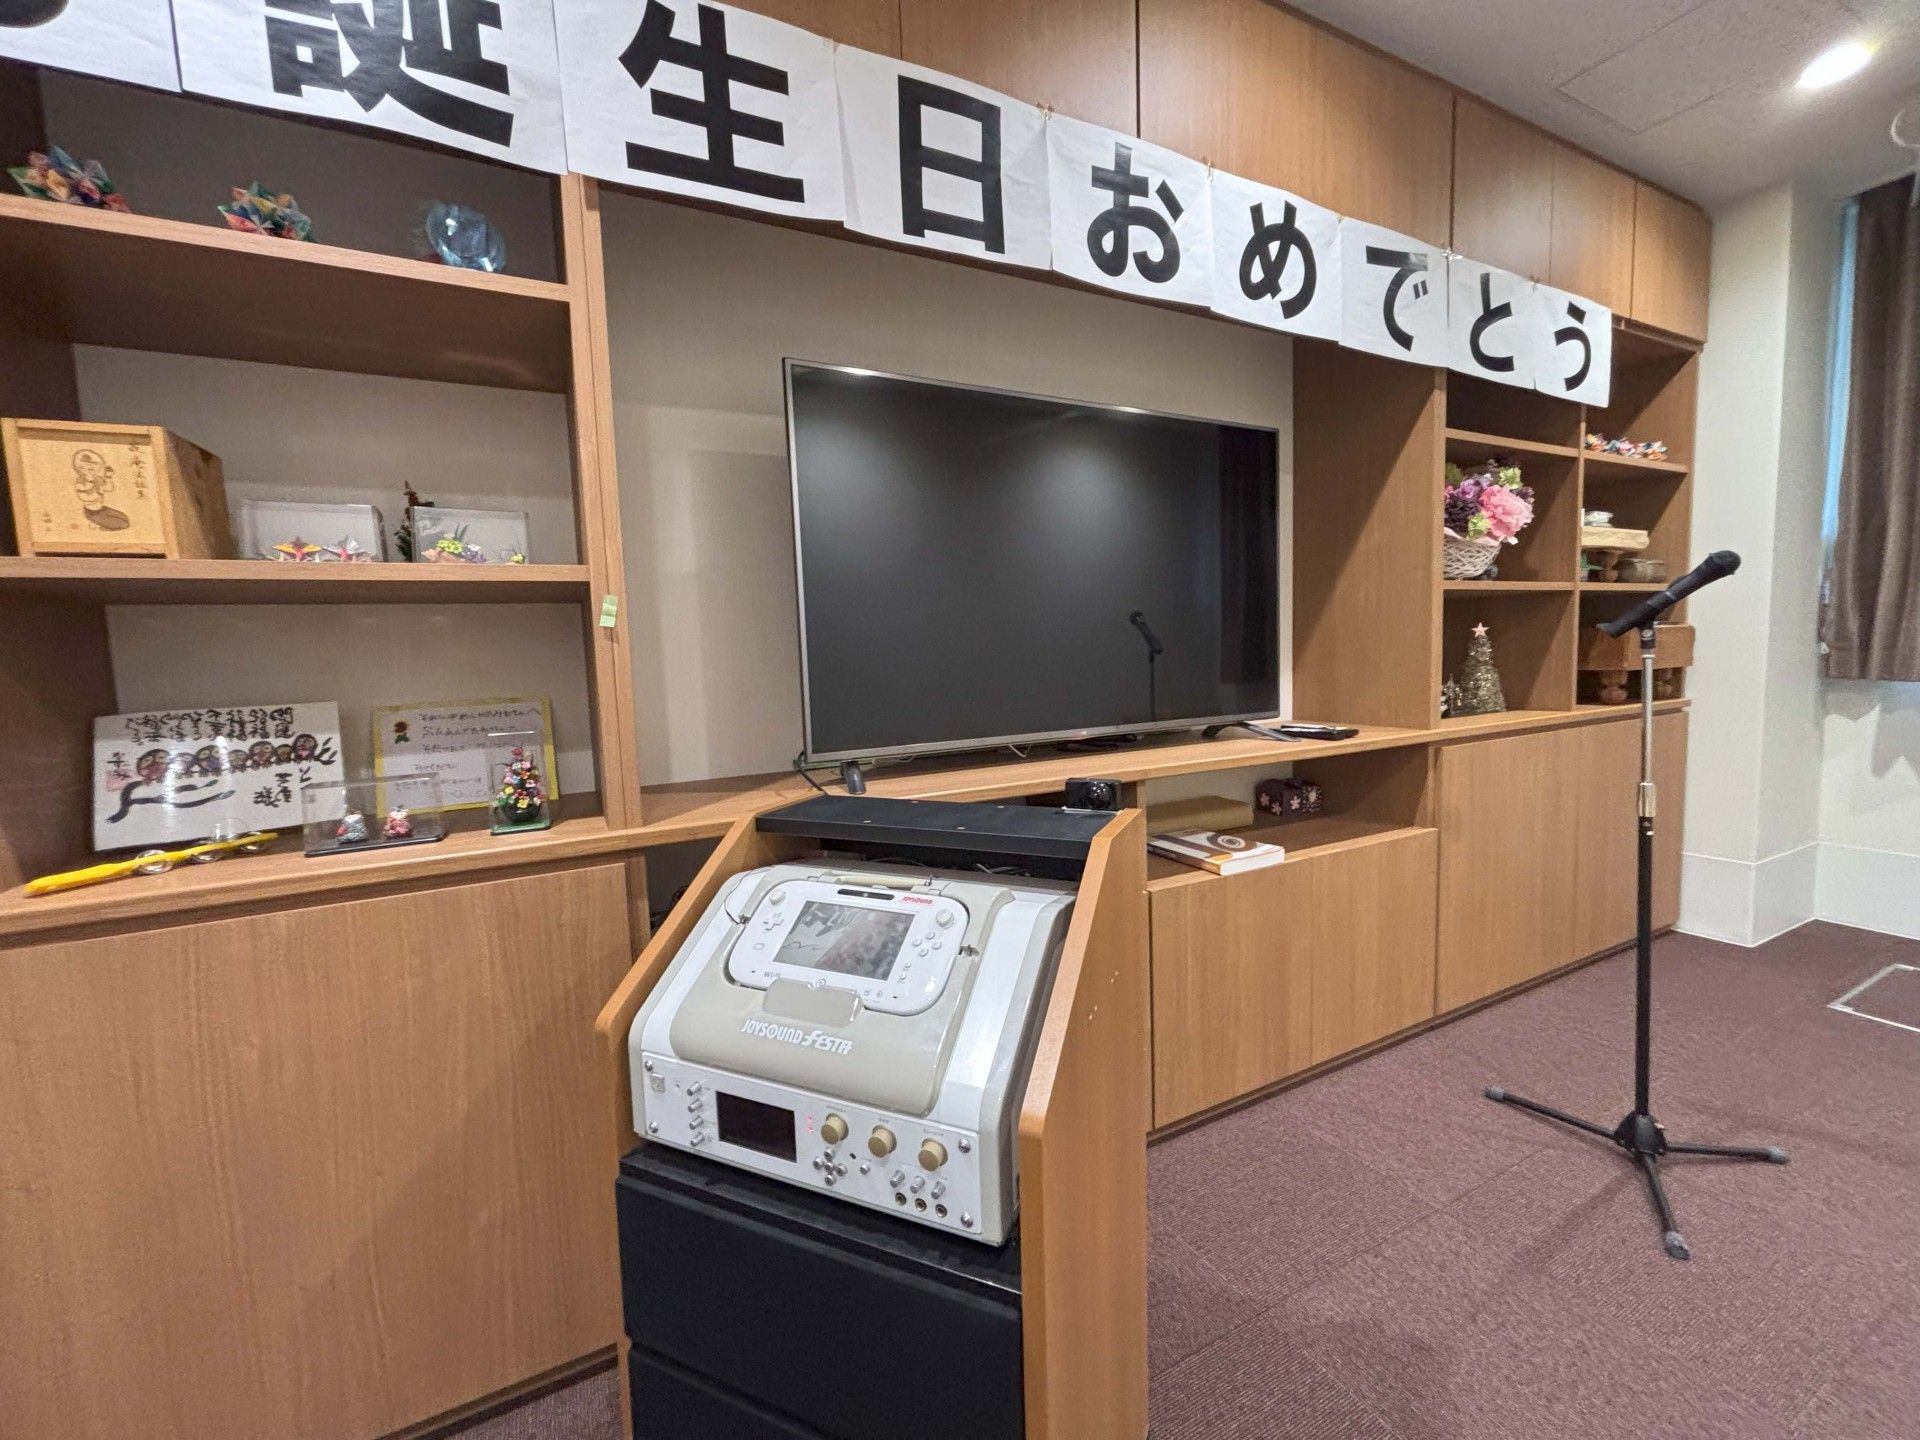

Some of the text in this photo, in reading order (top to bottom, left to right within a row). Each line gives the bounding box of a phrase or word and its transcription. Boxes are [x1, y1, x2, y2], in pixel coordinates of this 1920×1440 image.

[0, 0, 1592, 392] 誕生日おめでとう
[741, 1019, 803, 1045] JOYSOUND
